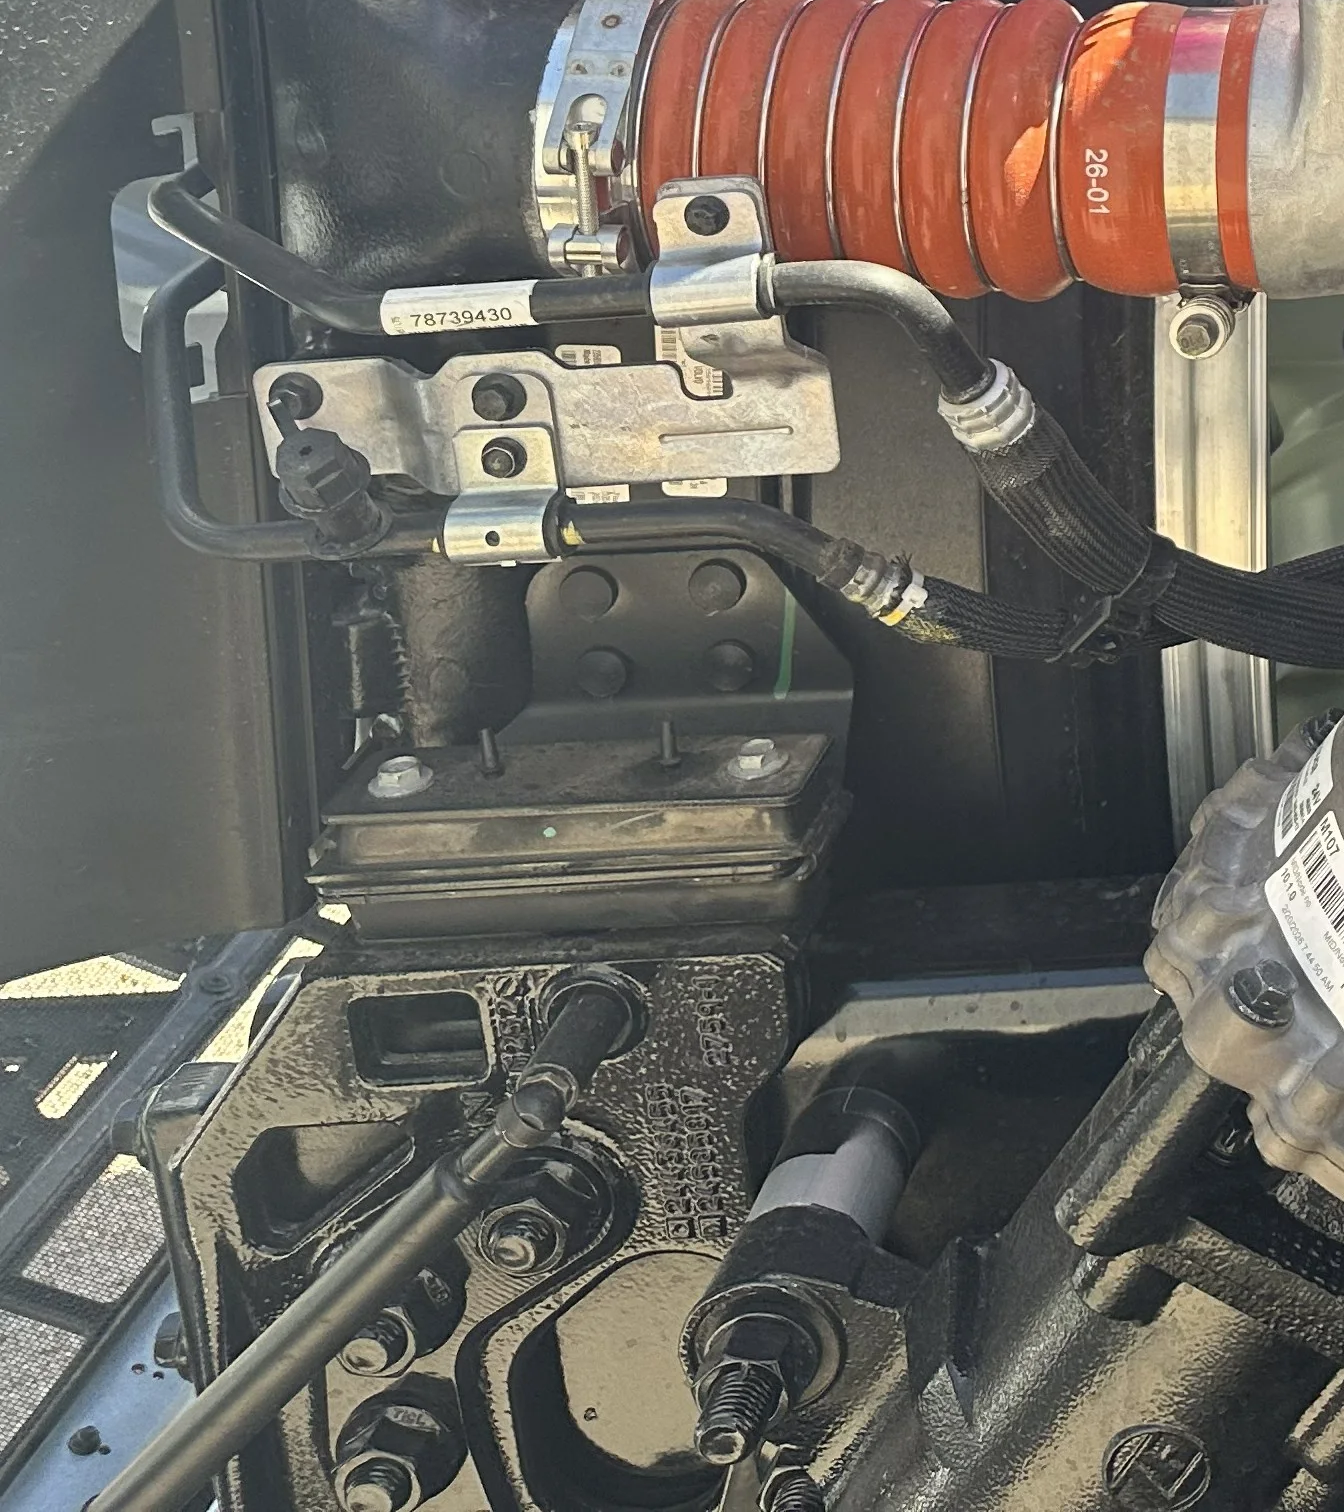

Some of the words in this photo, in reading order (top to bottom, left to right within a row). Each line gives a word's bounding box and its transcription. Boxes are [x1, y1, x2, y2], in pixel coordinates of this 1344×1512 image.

[1084, 148, 1111, 215] 26-01
[410, 307, 512, 328] 78739430
[1318, 818, 1340, 857] M107
[1319, 974, 1334, 994] AM
